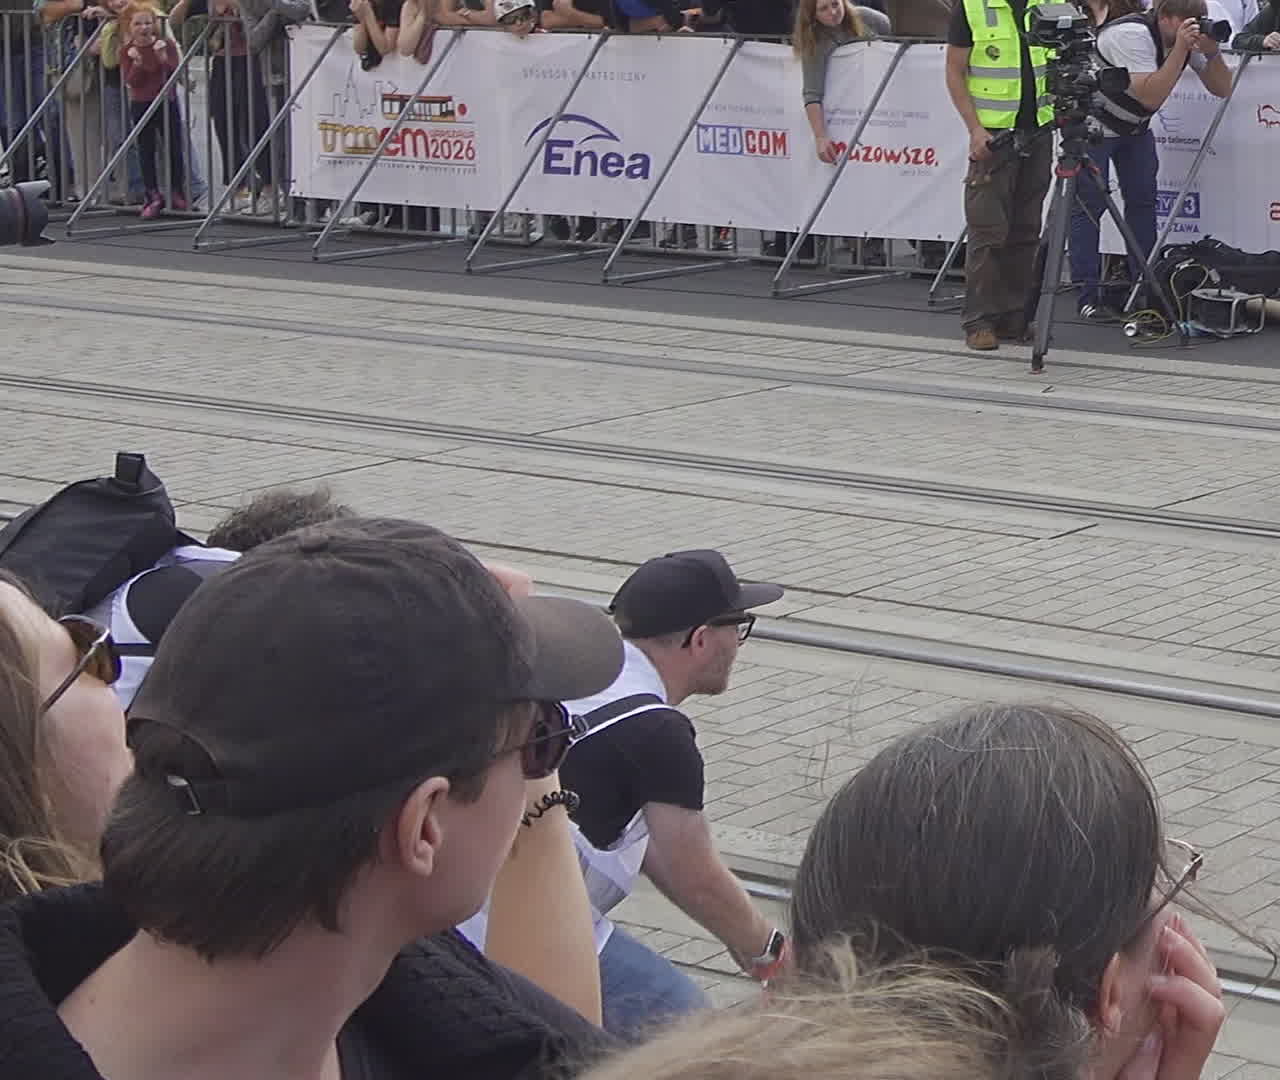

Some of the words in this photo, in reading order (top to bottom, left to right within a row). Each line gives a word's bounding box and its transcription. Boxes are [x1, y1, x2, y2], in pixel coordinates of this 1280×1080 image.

[431, 139, 475, 161] 2026
[699, 126, 788, 156] MEDCOM
[542, 139, 651, 180] Enea
